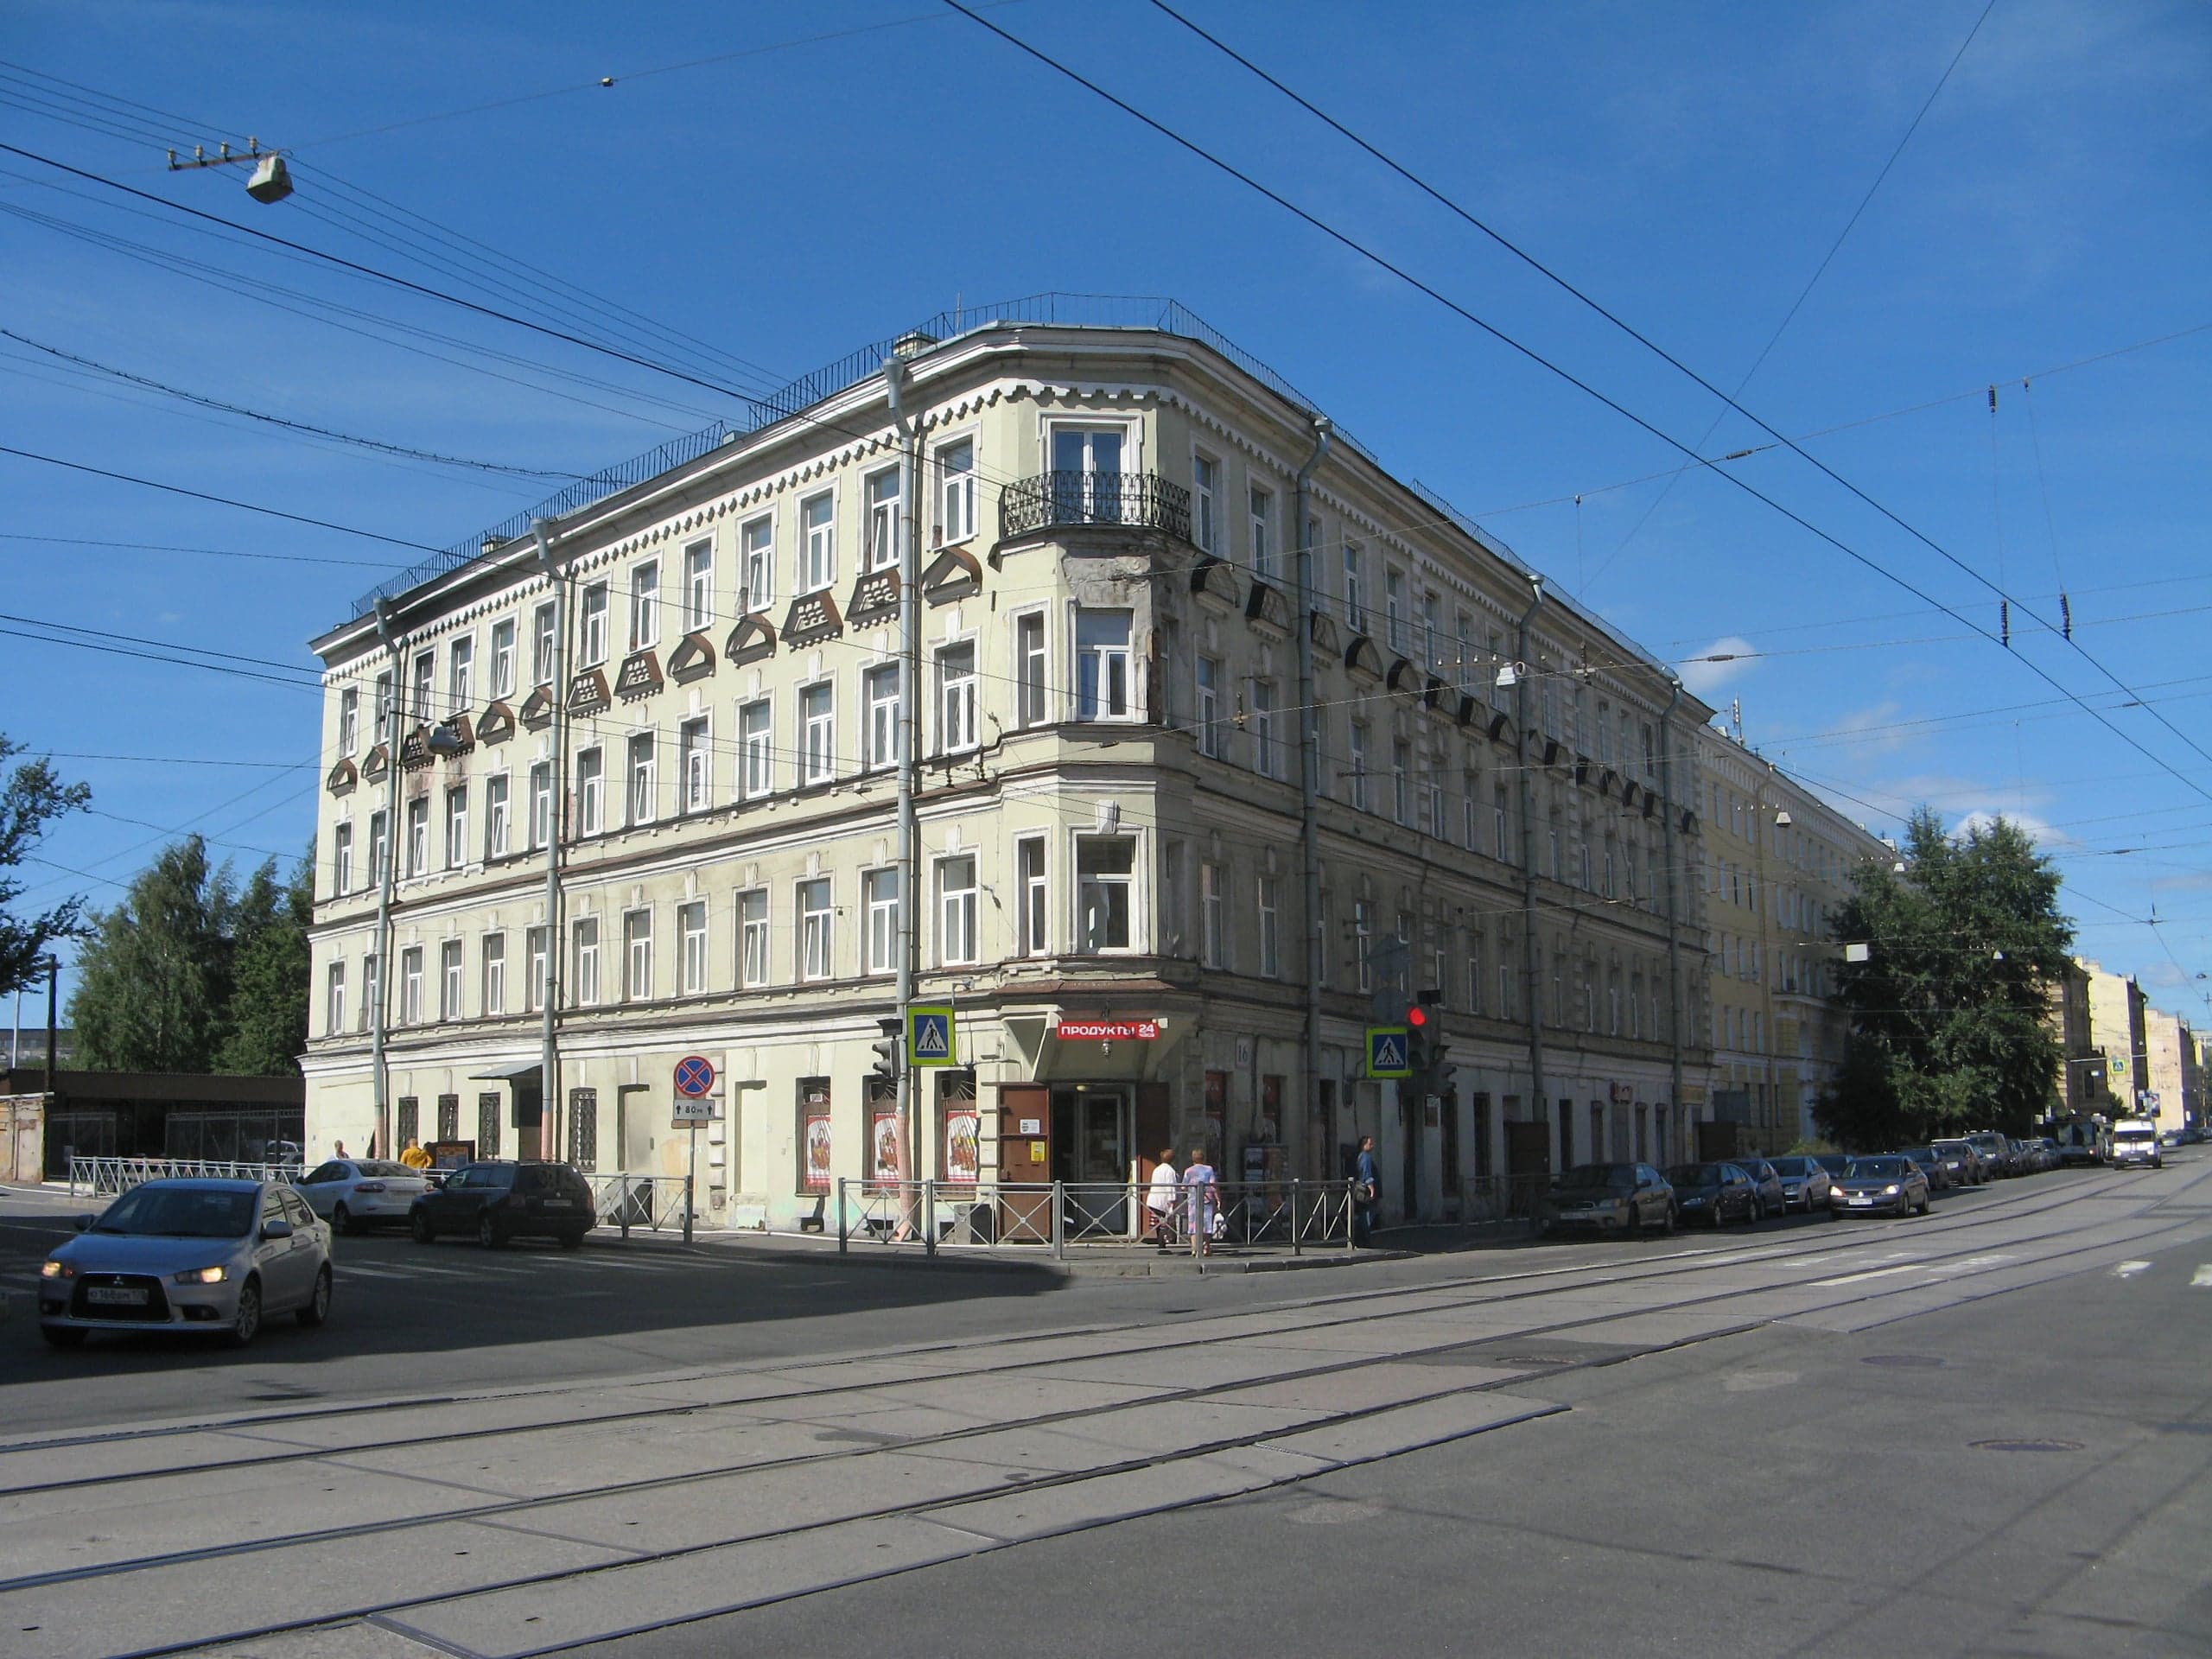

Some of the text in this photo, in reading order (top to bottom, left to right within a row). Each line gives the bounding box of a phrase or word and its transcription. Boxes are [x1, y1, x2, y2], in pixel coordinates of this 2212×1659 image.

[1061, 1026, 1135, 1036] ПРОДУКТЫ
[1138, 1024, 1154, 1033] 24
[685, 1105, 696, 1114] 80
